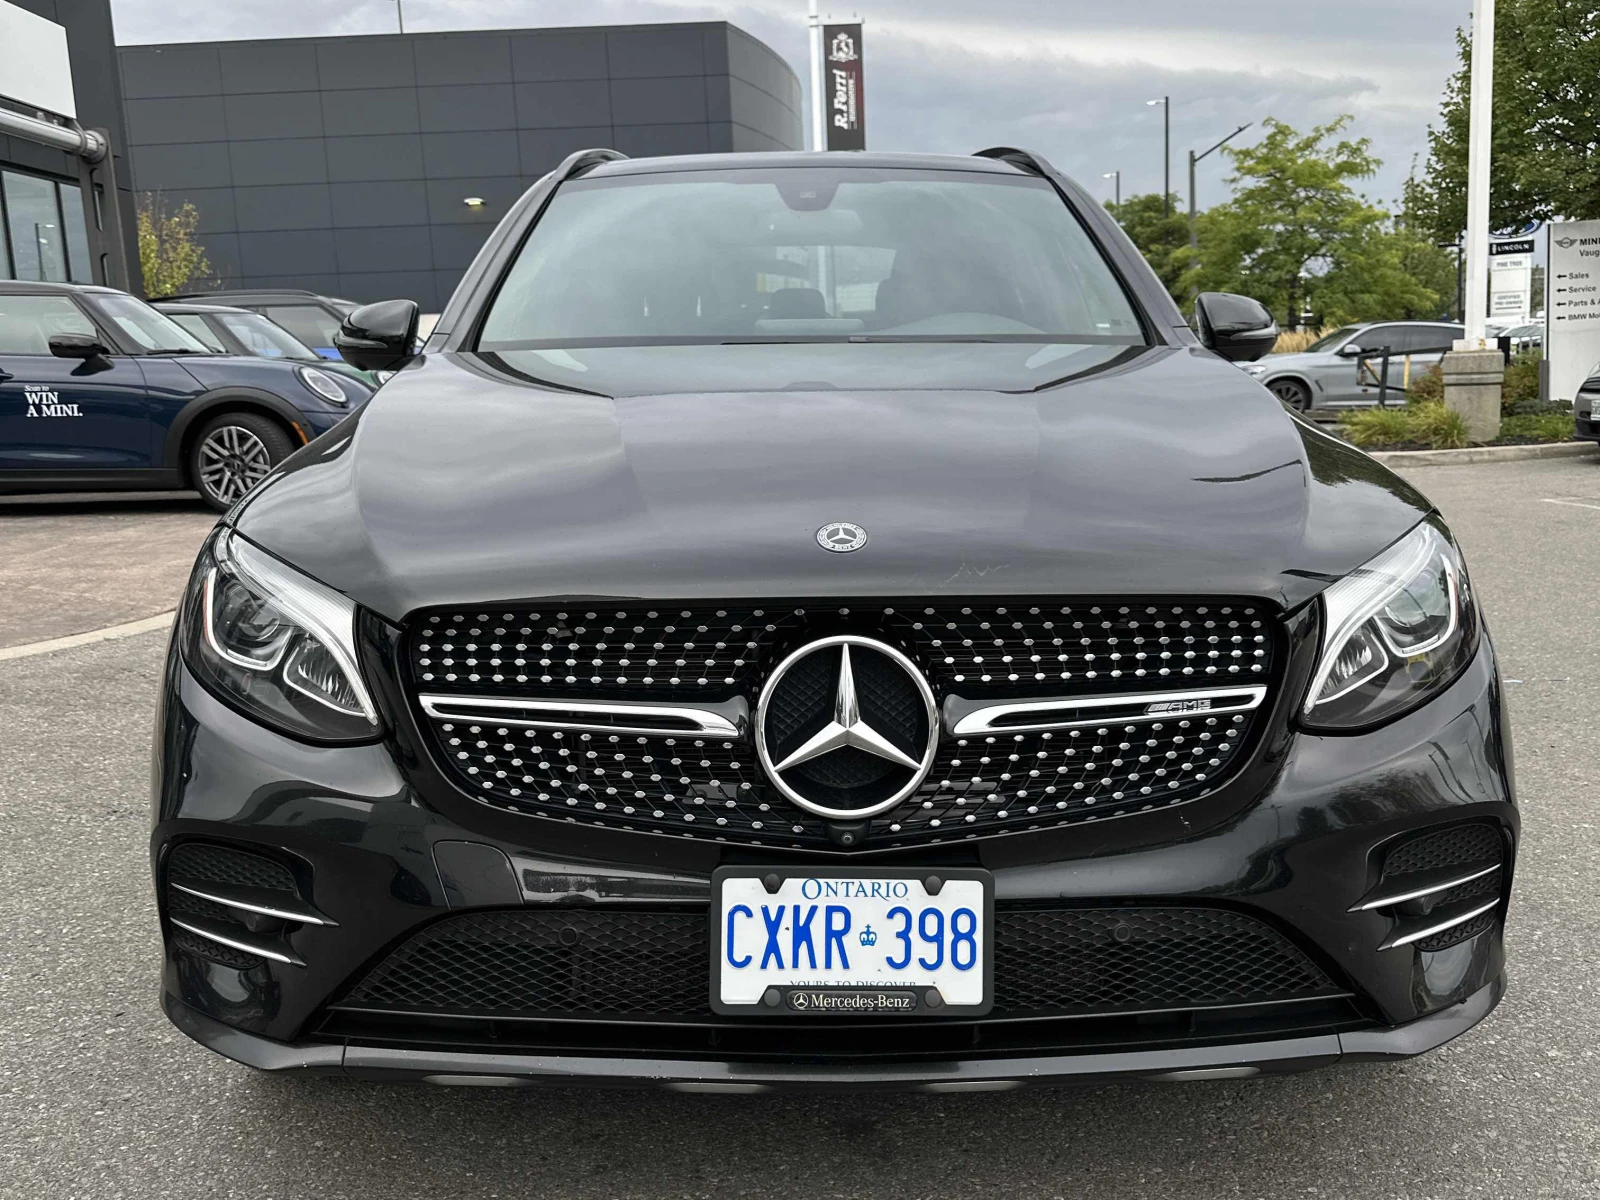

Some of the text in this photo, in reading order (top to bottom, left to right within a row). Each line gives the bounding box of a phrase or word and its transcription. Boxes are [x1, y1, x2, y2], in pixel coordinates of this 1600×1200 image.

[1497, 243, 1530, 252] LINCOLN
[1568, 272, 1589, 280] Sales
[1568, 285, 1597, 294] Service
[1568, 299, 1588, 307] Parts
[24, 391, 59, 404] WIN
[26, 404, 83, 417] A MINI.
[1168, 699, 1211, 711] AMG
[727, 904, 977, 971] CXKR 398
[811, 994, 910, 1009] Mercedes-Benz
